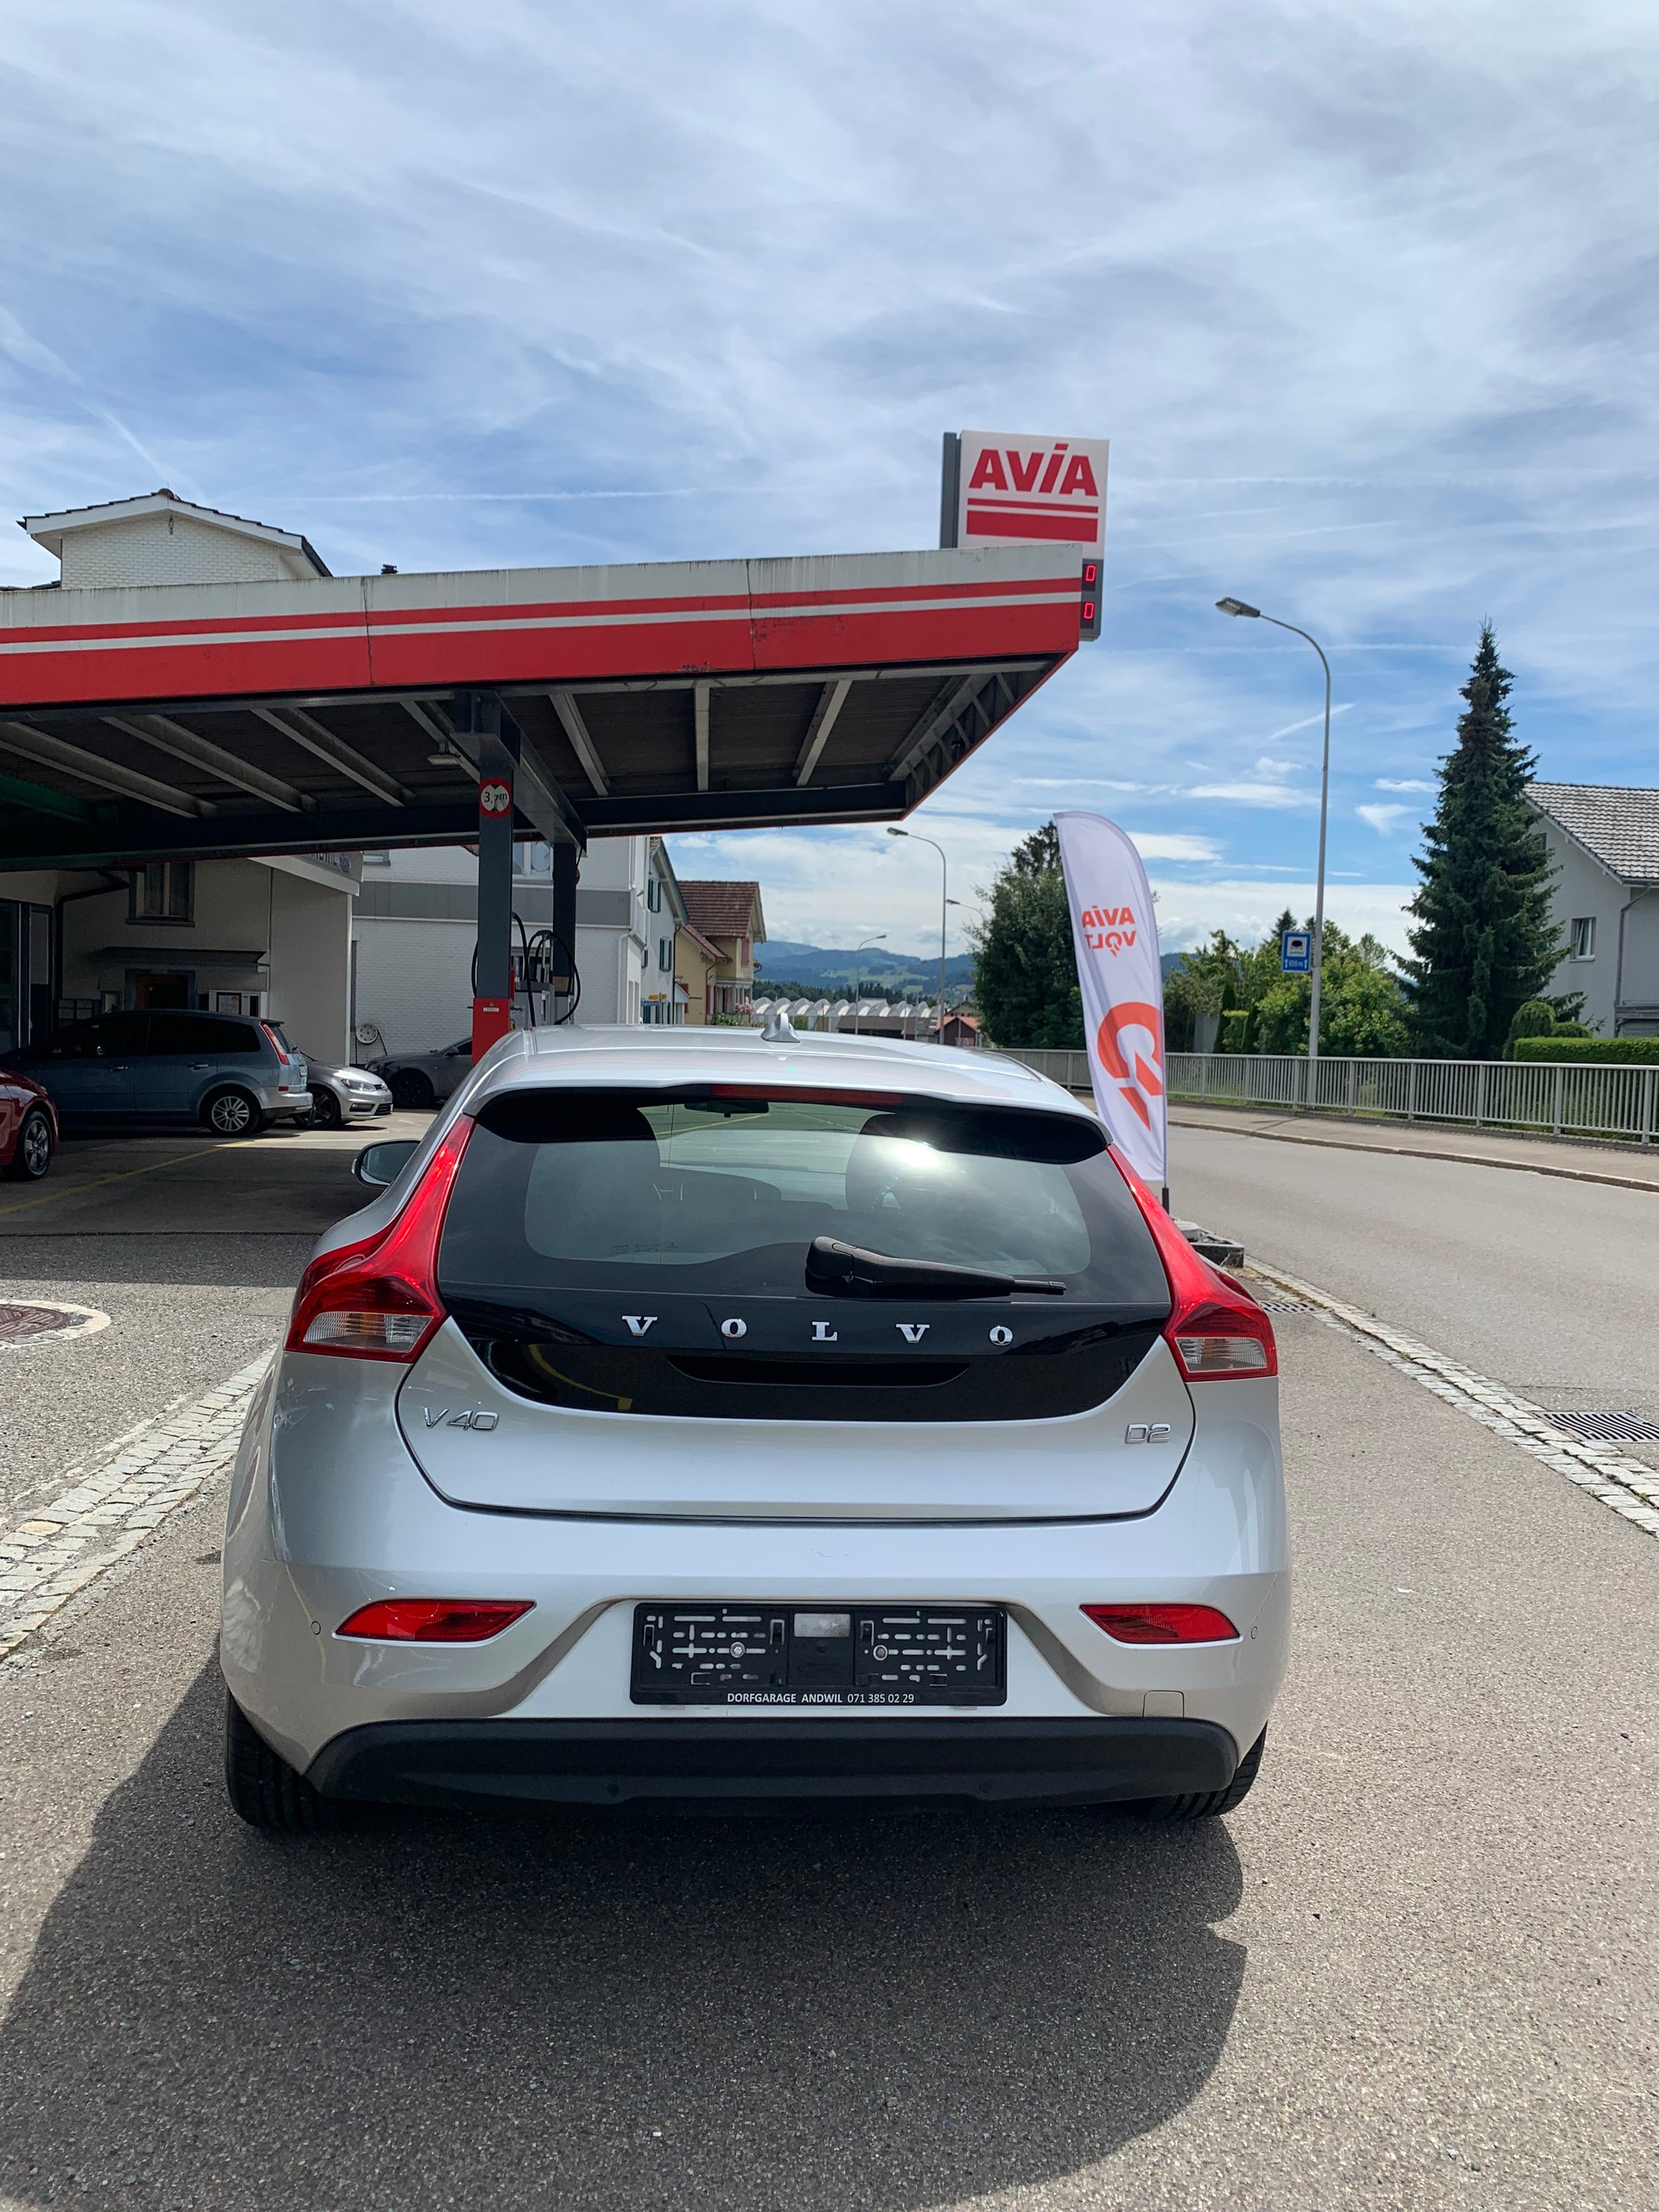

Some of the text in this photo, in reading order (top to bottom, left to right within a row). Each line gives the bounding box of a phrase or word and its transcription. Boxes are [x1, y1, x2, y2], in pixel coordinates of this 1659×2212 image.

[621, 1314, 1014, 1346] VOLVO
[423, 1407, 499, 1432] V40
[1124, 1423, 1171, 1444] D2
[727, 1693, 915, 1703] DORFGARAGE ANDWIL 071 385 02 29
